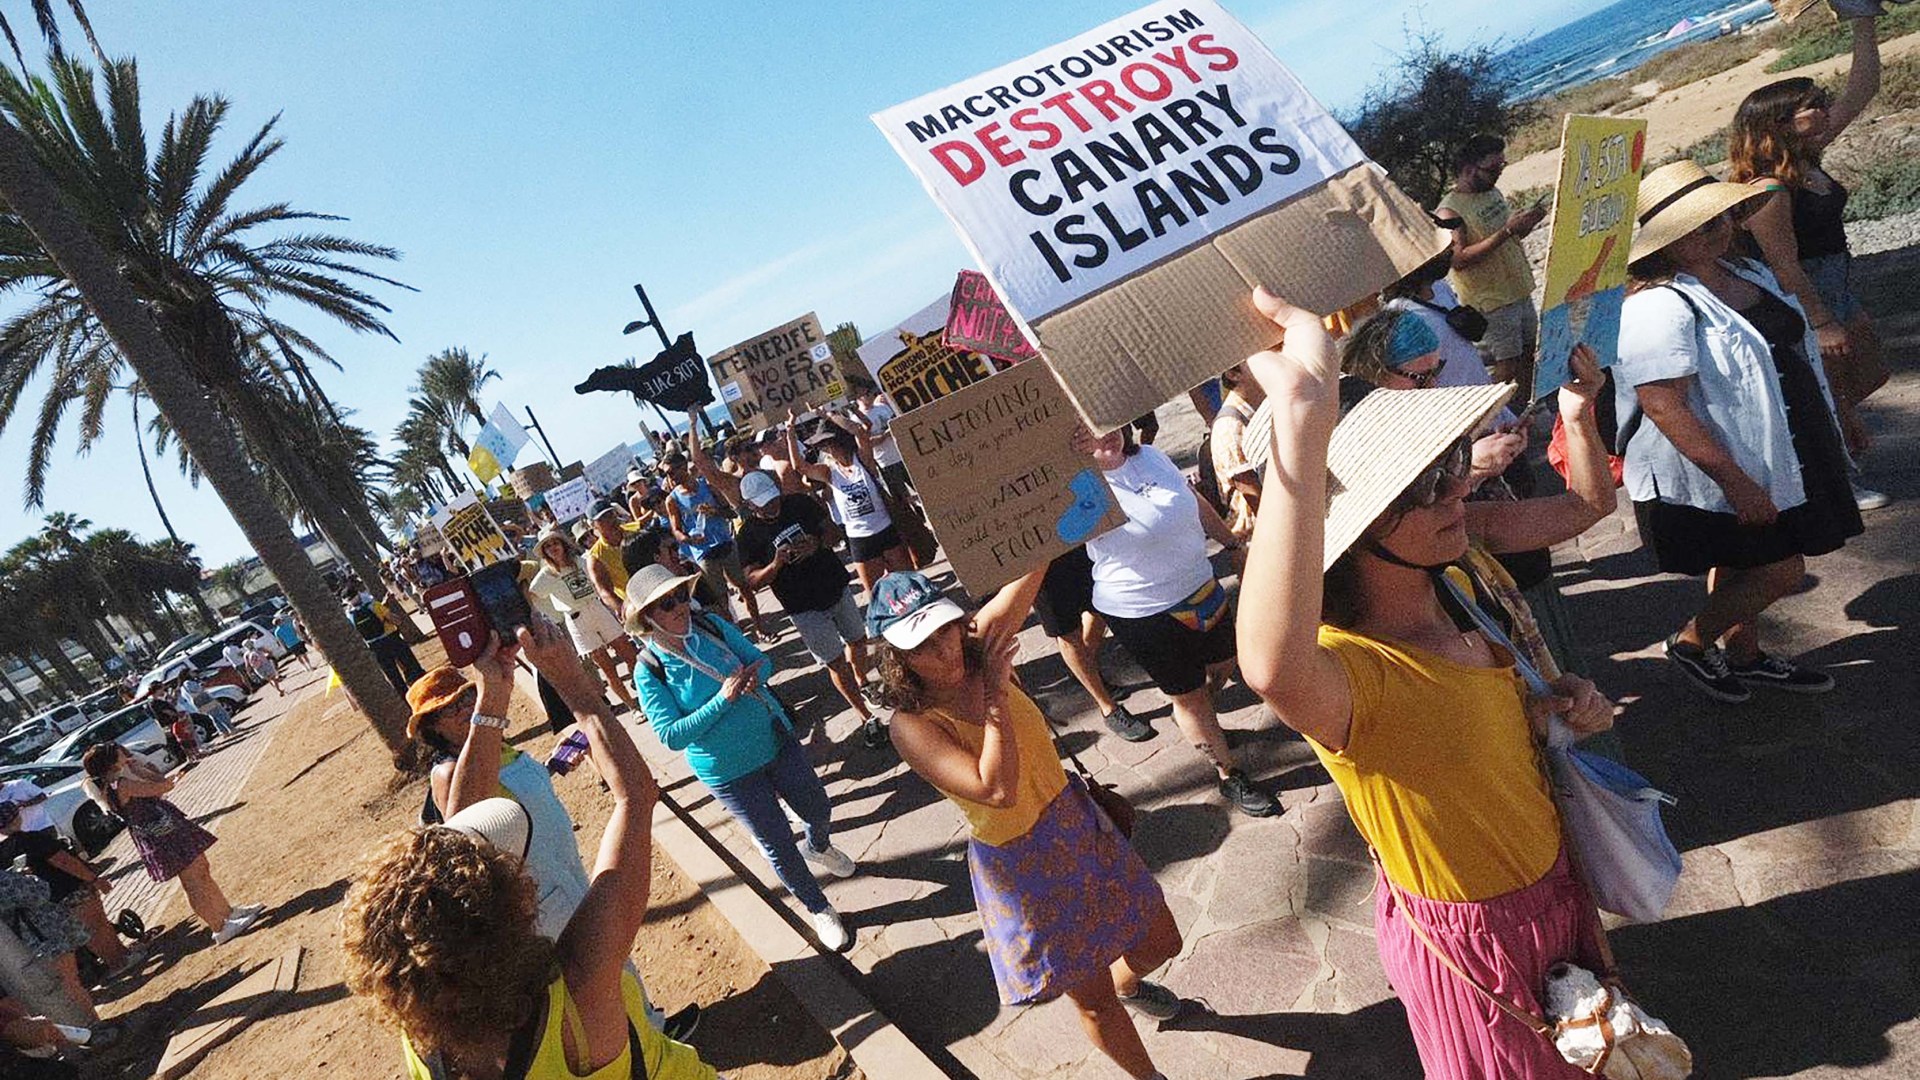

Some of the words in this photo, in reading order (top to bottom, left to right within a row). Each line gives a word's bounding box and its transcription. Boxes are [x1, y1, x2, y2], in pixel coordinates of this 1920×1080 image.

[905, 8, 1205, 143] MACROTOURISM
[929, 34, 1239, 187] DESTROYS
[1009, 84, 1247, 216] CANARY
[1029, 128, 1301, 283] ISLANDS
[711, 322, 817, 379] TENERIFE
[749, 367, 779, 391] NO
[785, 351, 813, 376] ES
[892, 349, 927, 376] TURISMO
[925, 341, 938, 355] DE
[736, 397, 763, 420] UN
[766, 363, 837, 408] SOLAR
[887, 371, 910, 391] NOS
[909, 378, 1040, 456] ENJOYING
[950, 449, 974, 472] day
[981, 464, 1059, 508] WATER
[449, 514, 499, 556] PICHE
[991, 524, 1052, 566] FOOD
